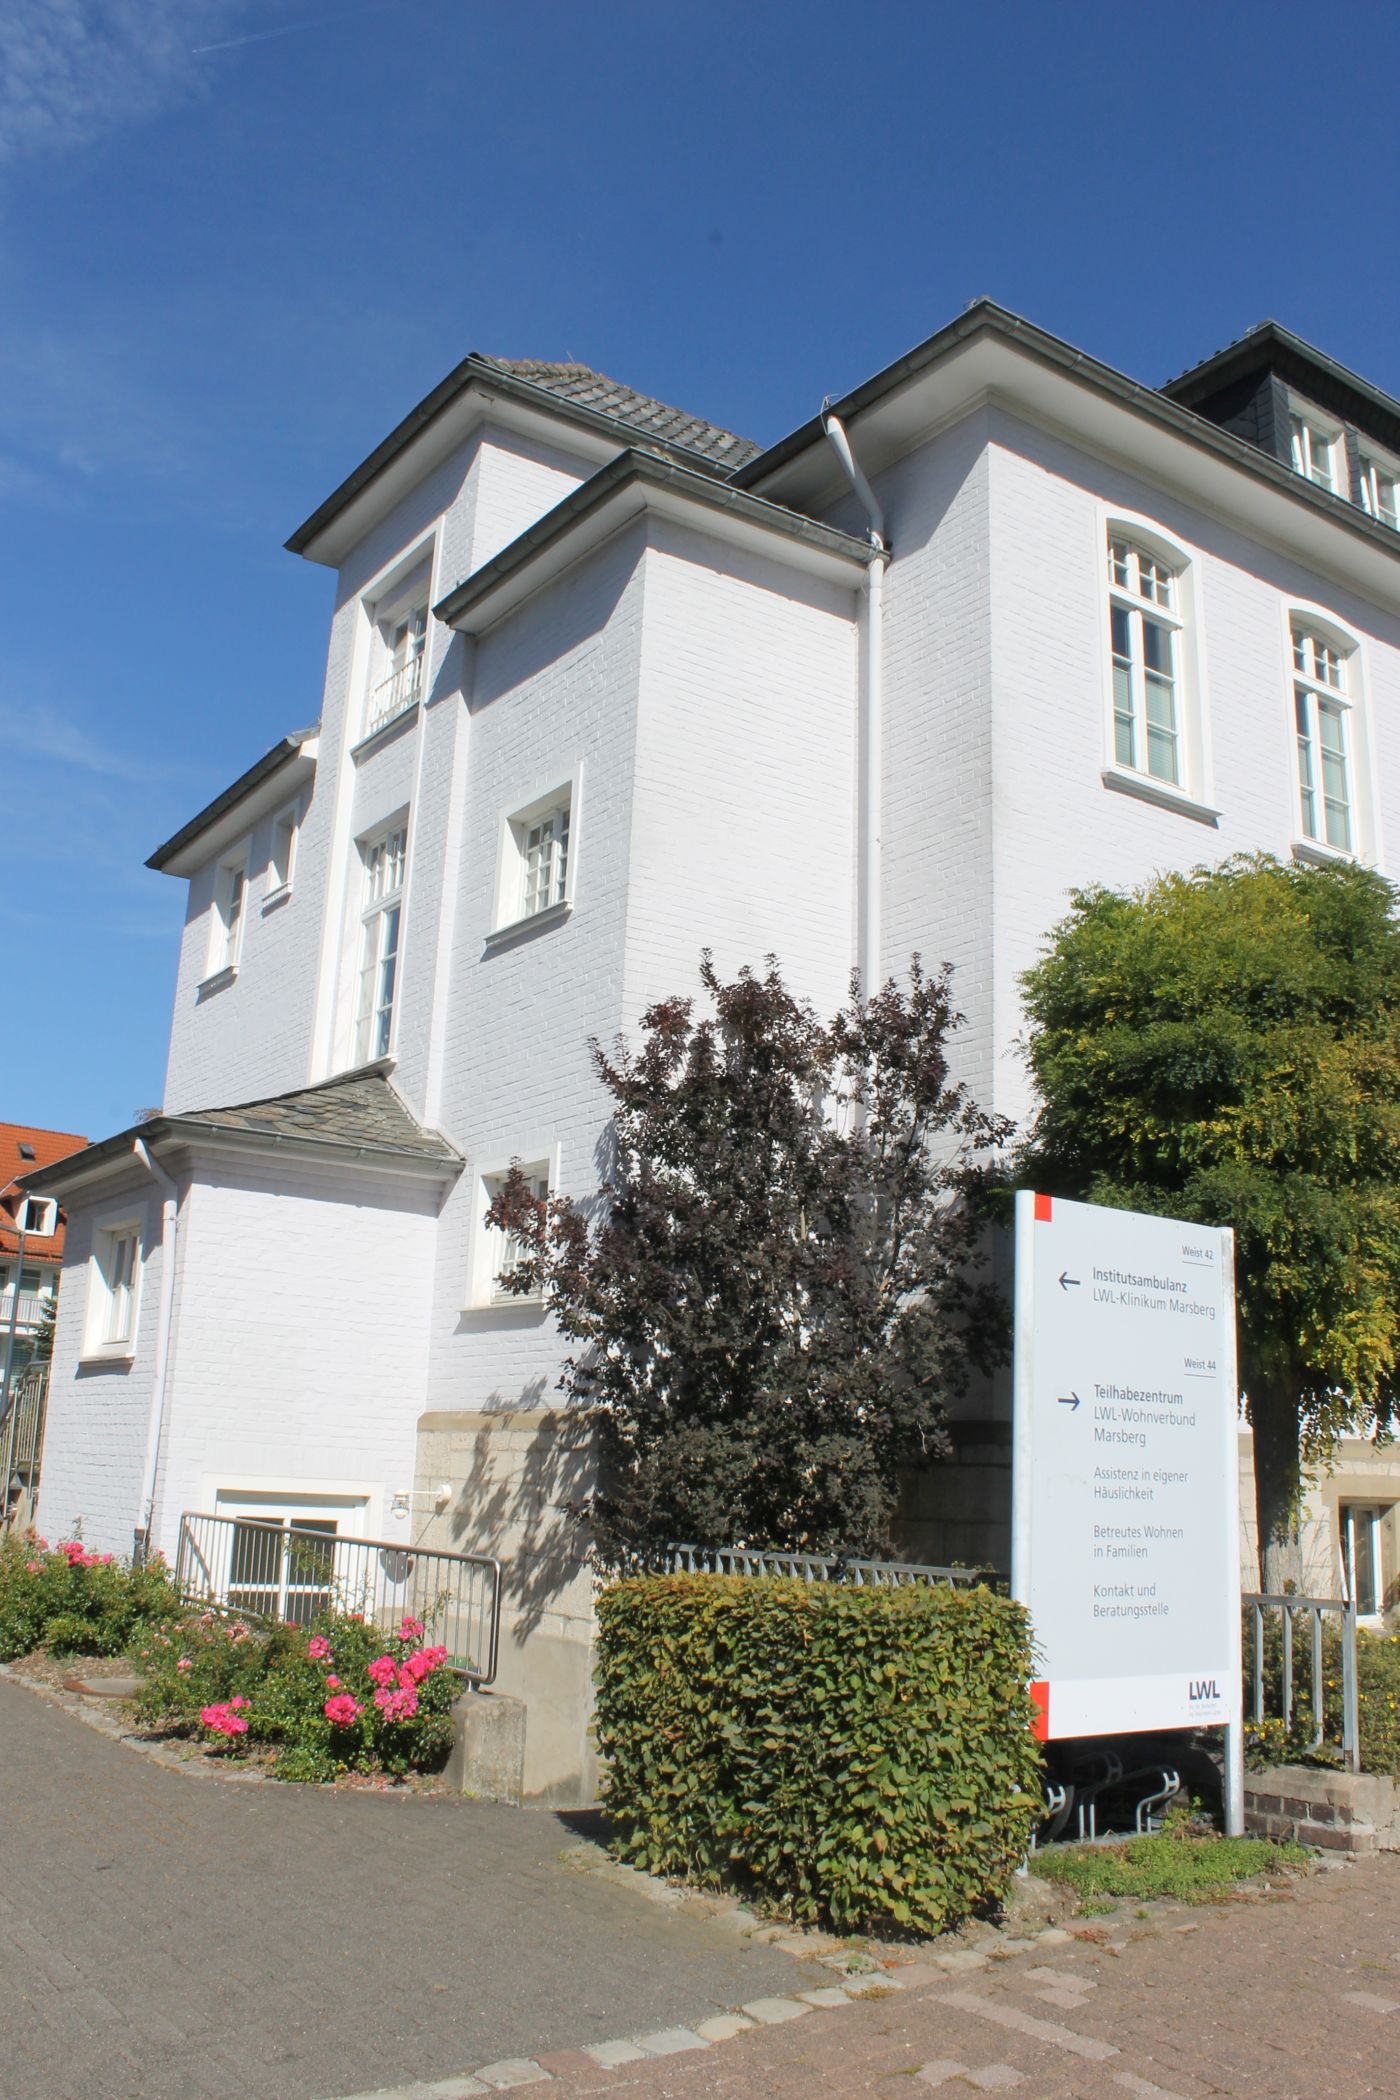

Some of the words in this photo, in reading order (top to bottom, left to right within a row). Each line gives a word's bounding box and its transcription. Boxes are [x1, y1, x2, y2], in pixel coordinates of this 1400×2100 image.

[1182, 1246, 1203, 1259] Weist
[1204, 1250, 1213, 1260] 42
[1093, 1267, 1187, 1293] Institutsambulanz
[1093, 1288, 1166, 1311] LWL-Klinikum
[1170, 1299, 1215, 1320] Marsberg
[1184, 1358, 1205, 1370] Weist
[1207, 1361, 1216, 1370] 44
[1094, 1384, 1183, 1404] Teilhabezentrum
[1094, 1406, 1195, 1426] LWL-Wohnverbund
[1094, 1428, 1146, 1447] Marsberg
[1094, 1466, 1139, 1481] Assistenz
[1142, 1467, 1150, 1481] in
[1154, 1471, 1188, 1484] eigener
[1094, 1486, 1154, 1500] Häuslichkeit
[1094, 1525, 1141, 1538] Betreutes
[1144, 1525, 1183, 1538] Wohnen
[1094, 1545, 1103, 1557] in
[1107, 1545, 1148, 1558] Familien
[1094, 1584, 1134, 1597] Kontakt
[1138, 1584, 1156, 1596] und
[1093, 1603, 1168, 1619] Beratungsstelle
[1189, 1679, 1220, 1700] LWL
